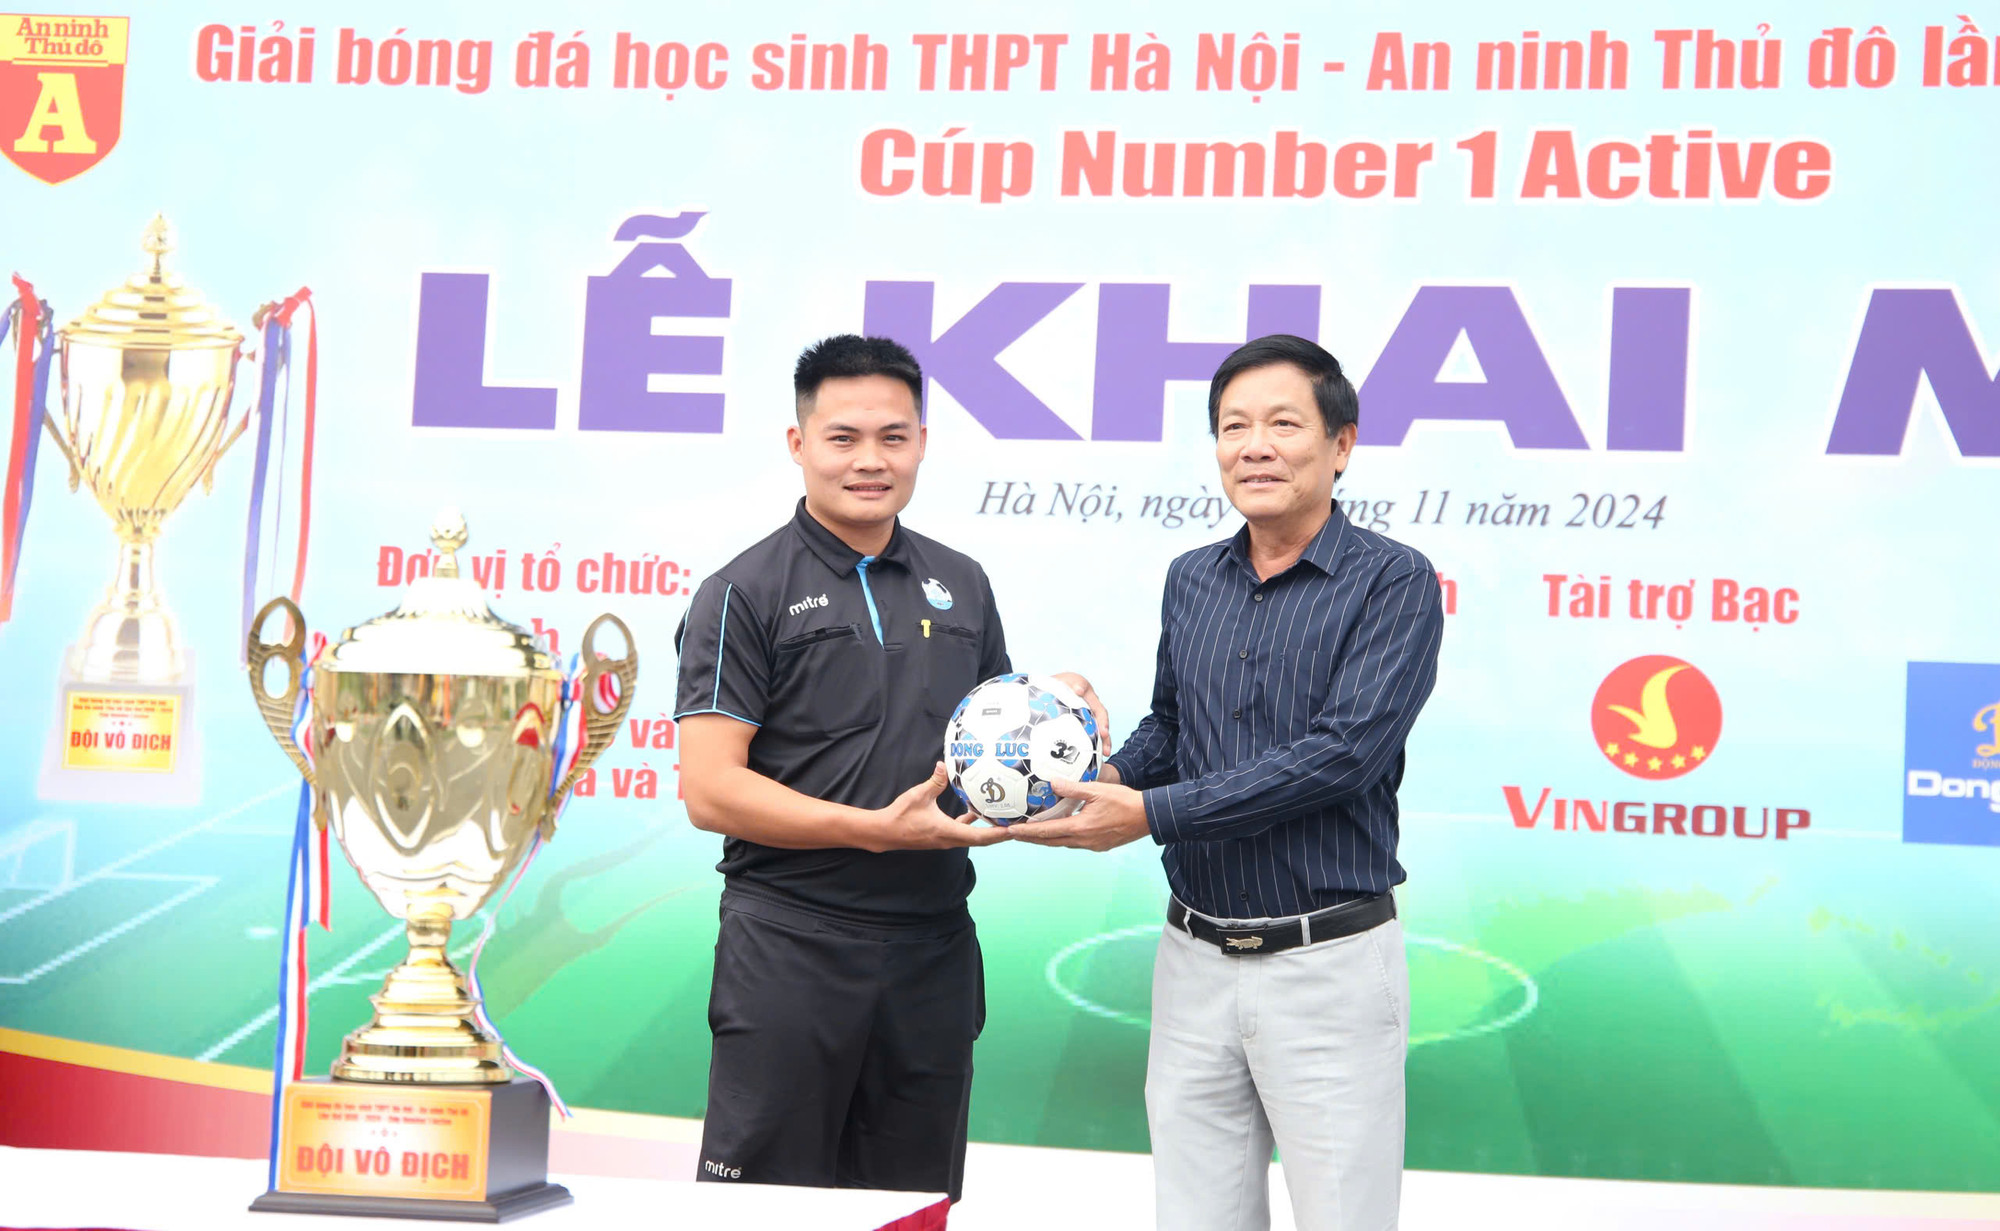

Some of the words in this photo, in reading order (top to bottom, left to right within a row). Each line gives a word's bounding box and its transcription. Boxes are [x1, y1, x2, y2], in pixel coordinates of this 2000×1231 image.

[16, 17, 51, 37] An
[54, 19, 109, 39] ninh
[196, 20, 315, 84] Giải
[337, 28, 493, 95] bóng
[515, 29, 590, 89] đá
[613, 32, 729, 101] học
[751, 33, 888, 91] sinh
[912, 33, 1069, 91] THPT
[1090, 32, 1171, 92] Hà
[1196, 31, 1300, 103] Nội
[1366, 32, 1451, 91] An
[1476, 30, 1628, 91] ninh
[1654, 23, 1782, 90] Thủ
[1807, 25, 1896, 89] đô
[1922, 14, 2000, 88] lầ
[13, 72, 98, 154] A
[860, 127, 1034, 204] Cúp
[1061, 130, 1433, 199] Number
[1456, 130, 1498, 198] 1
[1520, 130, 1831, 200] Active
[412, 211, 733, 434] LỄ
[863, 280, 1692, 452] KHAI
[976, 481, 1036, 515] Hà
[1046, 482, 1123, 524] Nội,
[1140, 485, 1232, 530] ngày
[1411, 490, 1450, 524] 11
[1465, 493, 1551, 527] năm
[1565, 493, 1668, 530] 2024
[471, 549, 507, 599] vị
[521, 542, 562, 593] tổ
[576, 552, 692, 596] chức:
[788, 593, 829, 616] mitre
[1542, 574, 1611, 619] Tài
[1627, 578, 1696, 630] trợ
[1711, 578, 1800, 633] Bạc
[629, 712, 675, 750] và
[611, 762, 658, 800] và
[1501, 785, 1811, 841] VINGROUP
[704, 1160, 741, 1179] mitre
